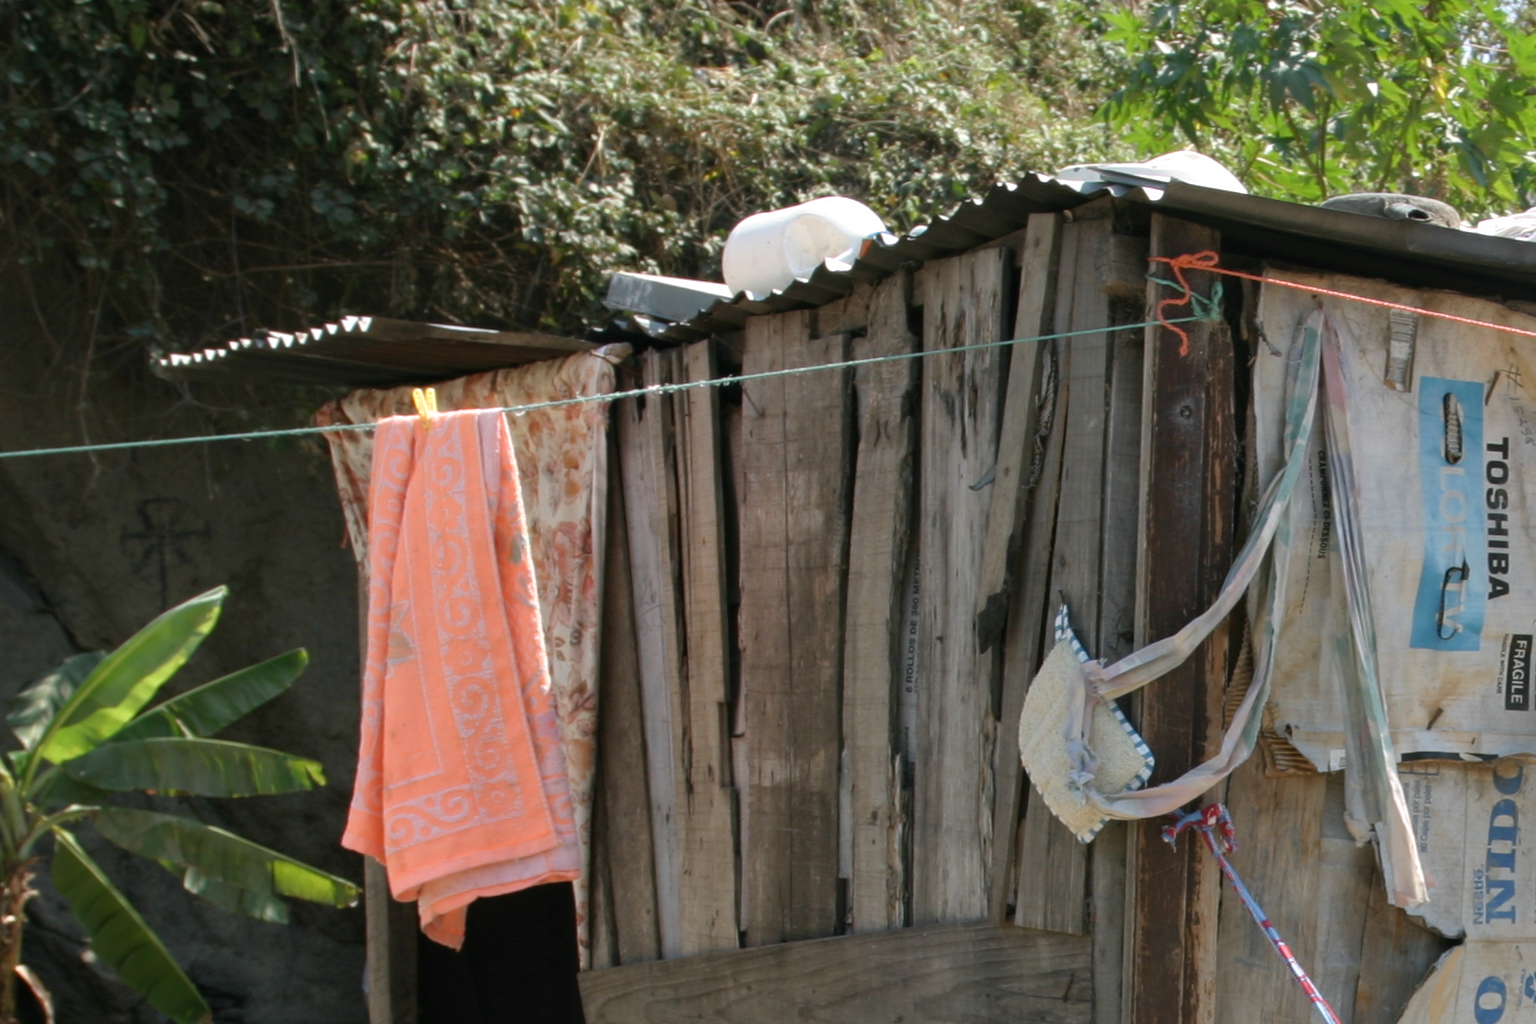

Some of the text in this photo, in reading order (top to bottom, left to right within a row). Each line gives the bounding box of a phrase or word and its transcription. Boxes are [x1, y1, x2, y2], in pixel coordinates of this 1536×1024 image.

[1486, 437, 1510, 600] TOSHIBA
[909, 620, 917, 634] DE
[905, 638, 916, 684] ROLLOS
[1510, 639, 1528, 703] FRAGILE
[1485, 760, 1524, 924] NIDO
